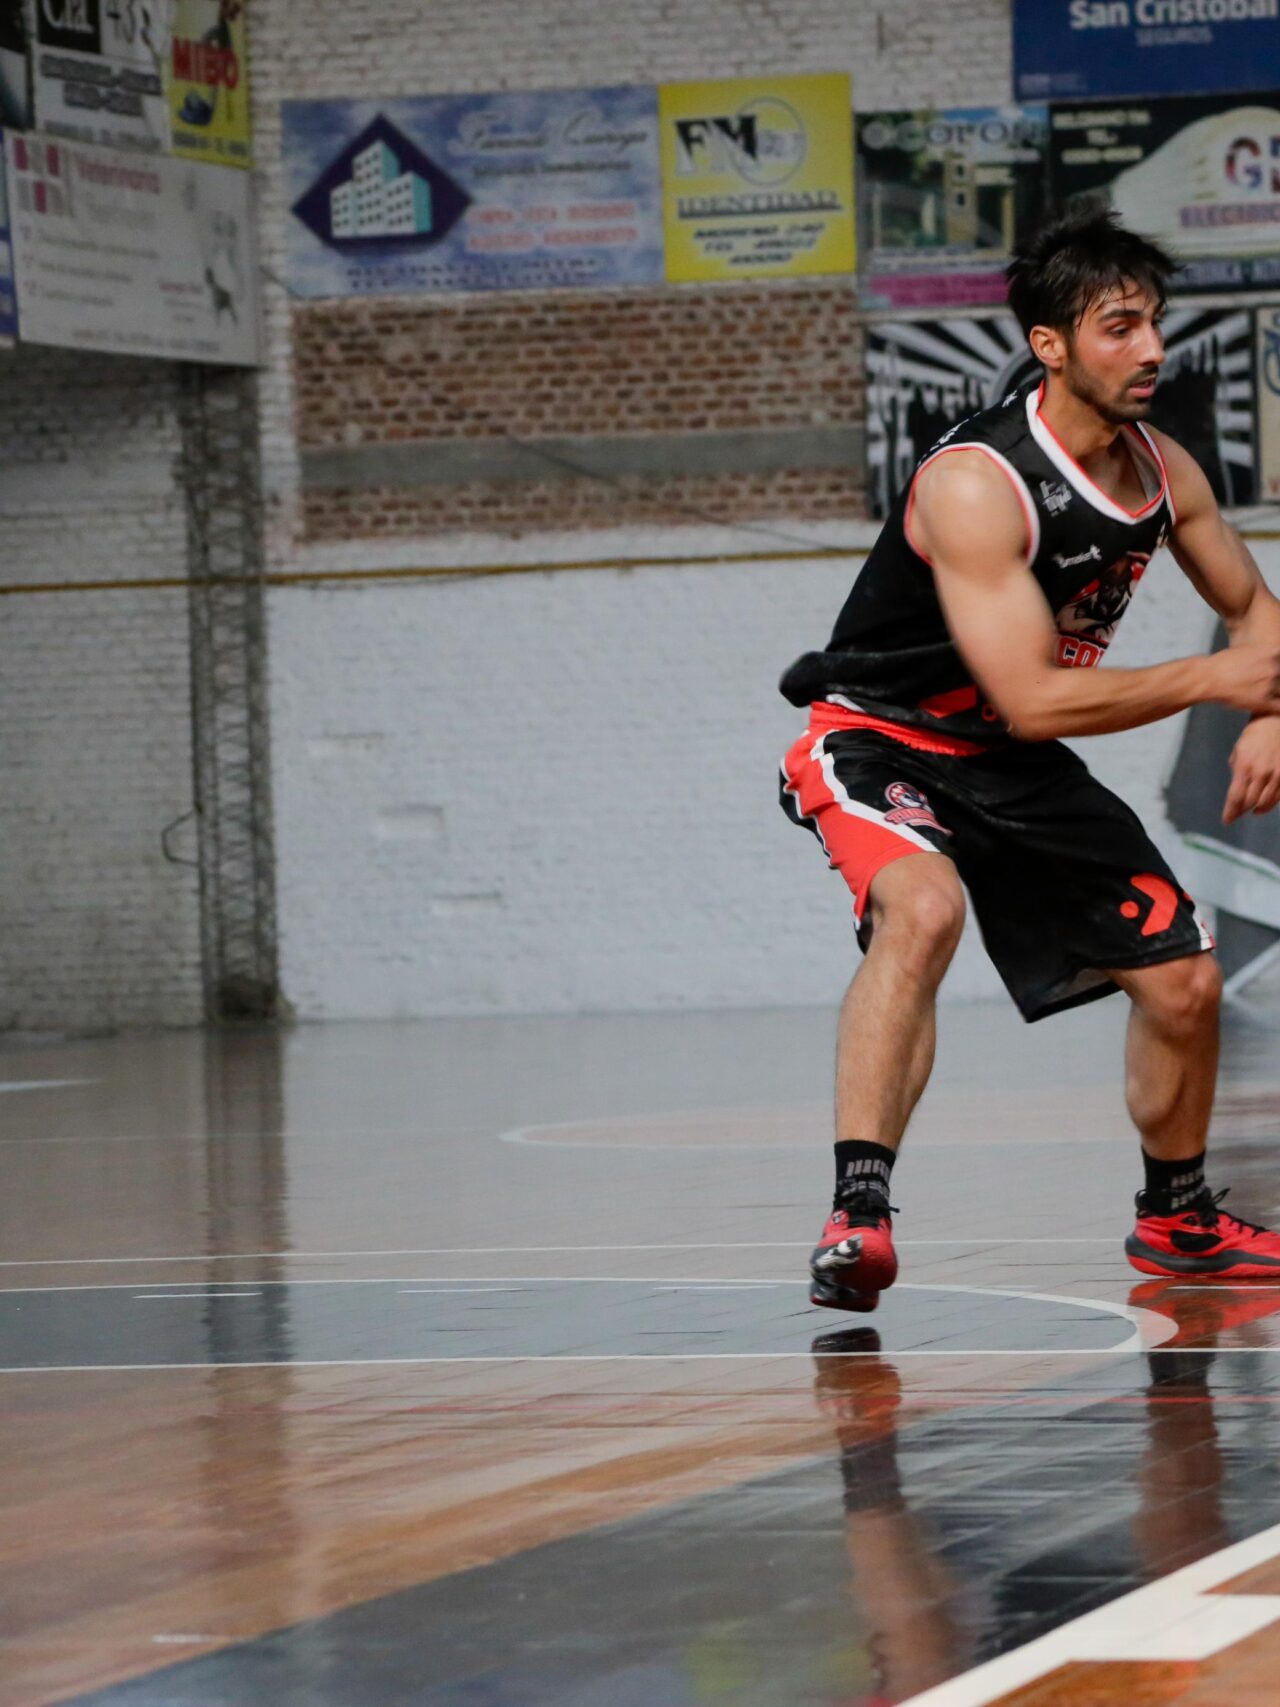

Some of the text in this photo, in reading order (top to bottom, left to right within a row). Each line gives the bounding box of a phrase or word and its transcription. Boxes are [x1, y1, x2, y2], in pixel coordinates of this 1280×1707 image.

[1070, 0, 1279, 30] San Cristobal
[1136, 27, 1213, 47] SEGUROS
